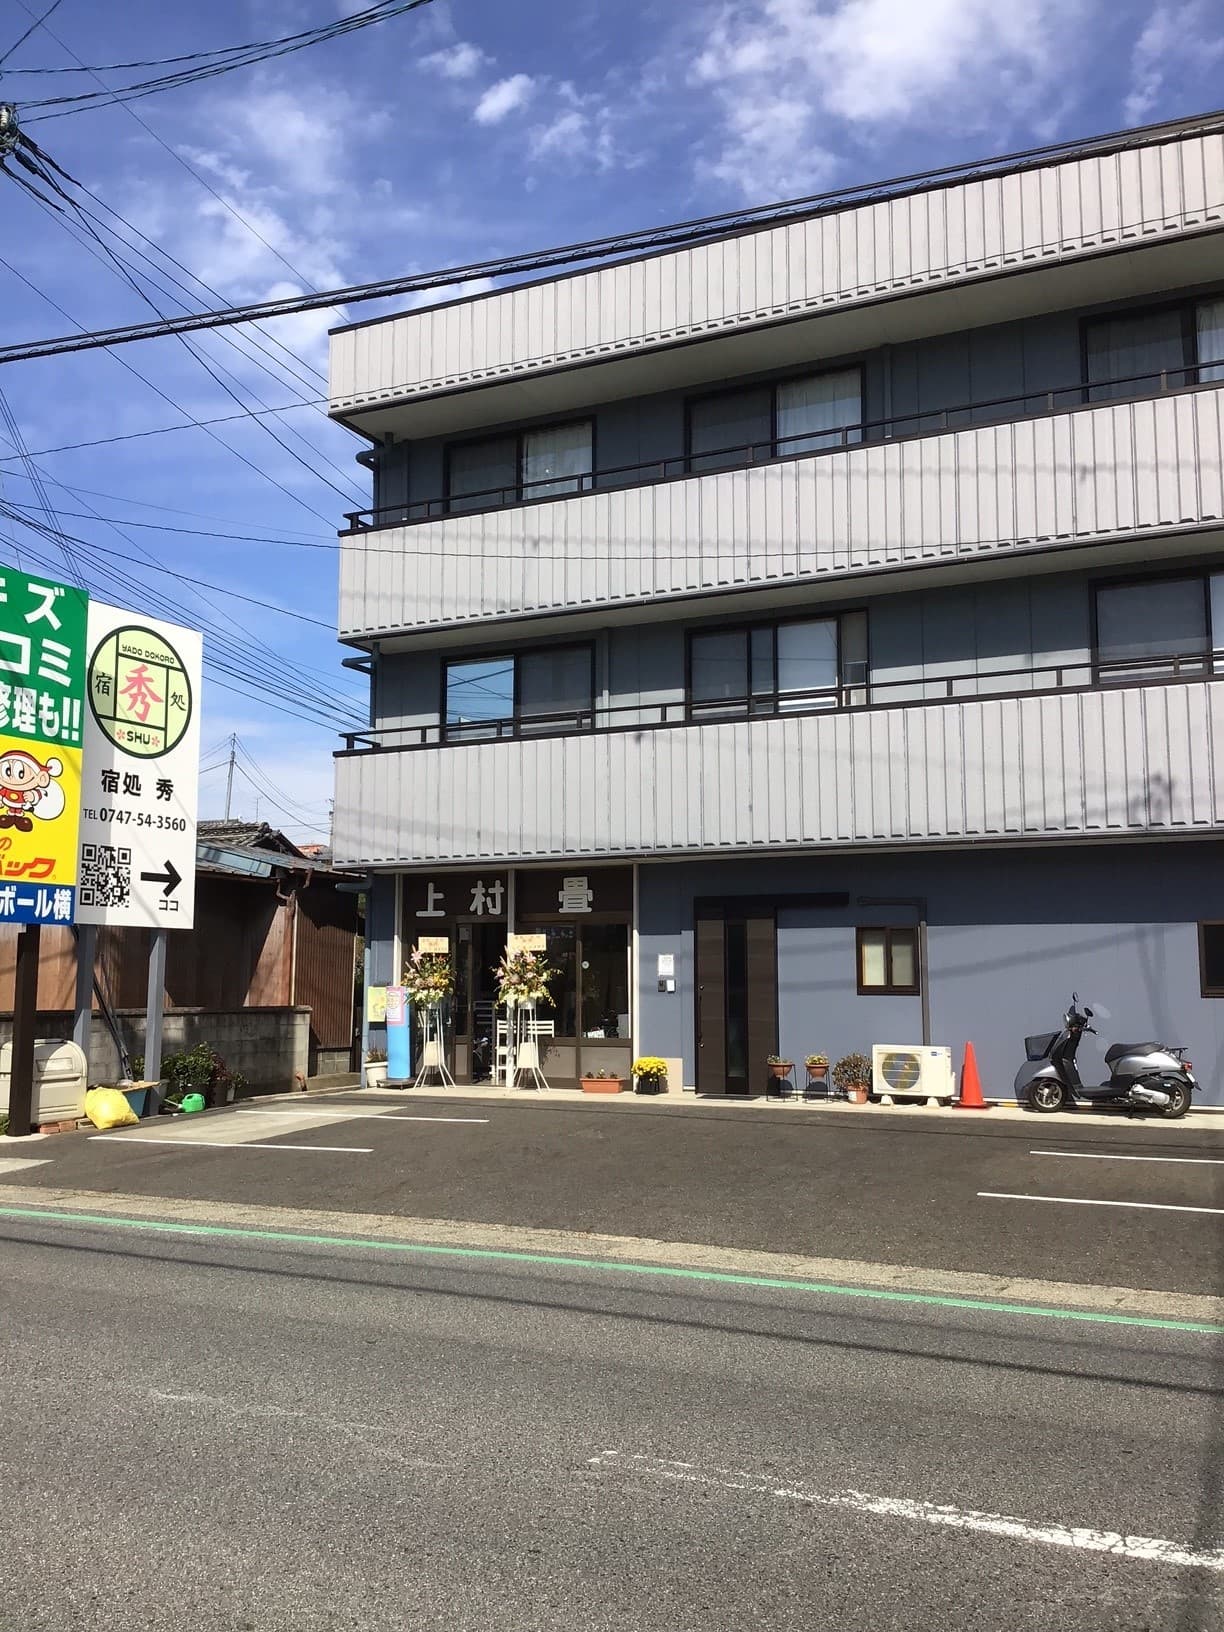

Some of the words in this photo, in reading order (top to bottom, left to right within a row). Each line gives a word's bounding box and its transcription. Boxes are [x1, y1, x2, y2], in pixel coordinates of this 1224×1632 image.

[0, 577, 66, 632] ズ
[121, 643, 143, 656] YADO
[144, 649, 175, 665] DOKORO
[95, 672, 113, 697] 宿
[119, 663, 164, 722] 秀
[170, 691, 187, 712] 処
[126, 730, 151, 745] SHU
[101, 768, 142, 797] 宿処
[156, 778, 174, 801] 秀
[83, 808, 98, 820] TEL
[99, 807, 187, 832] 0747-54-3560
[0, 885, 72, 921] ボール横
[158, 899, 179, 912] ココ
